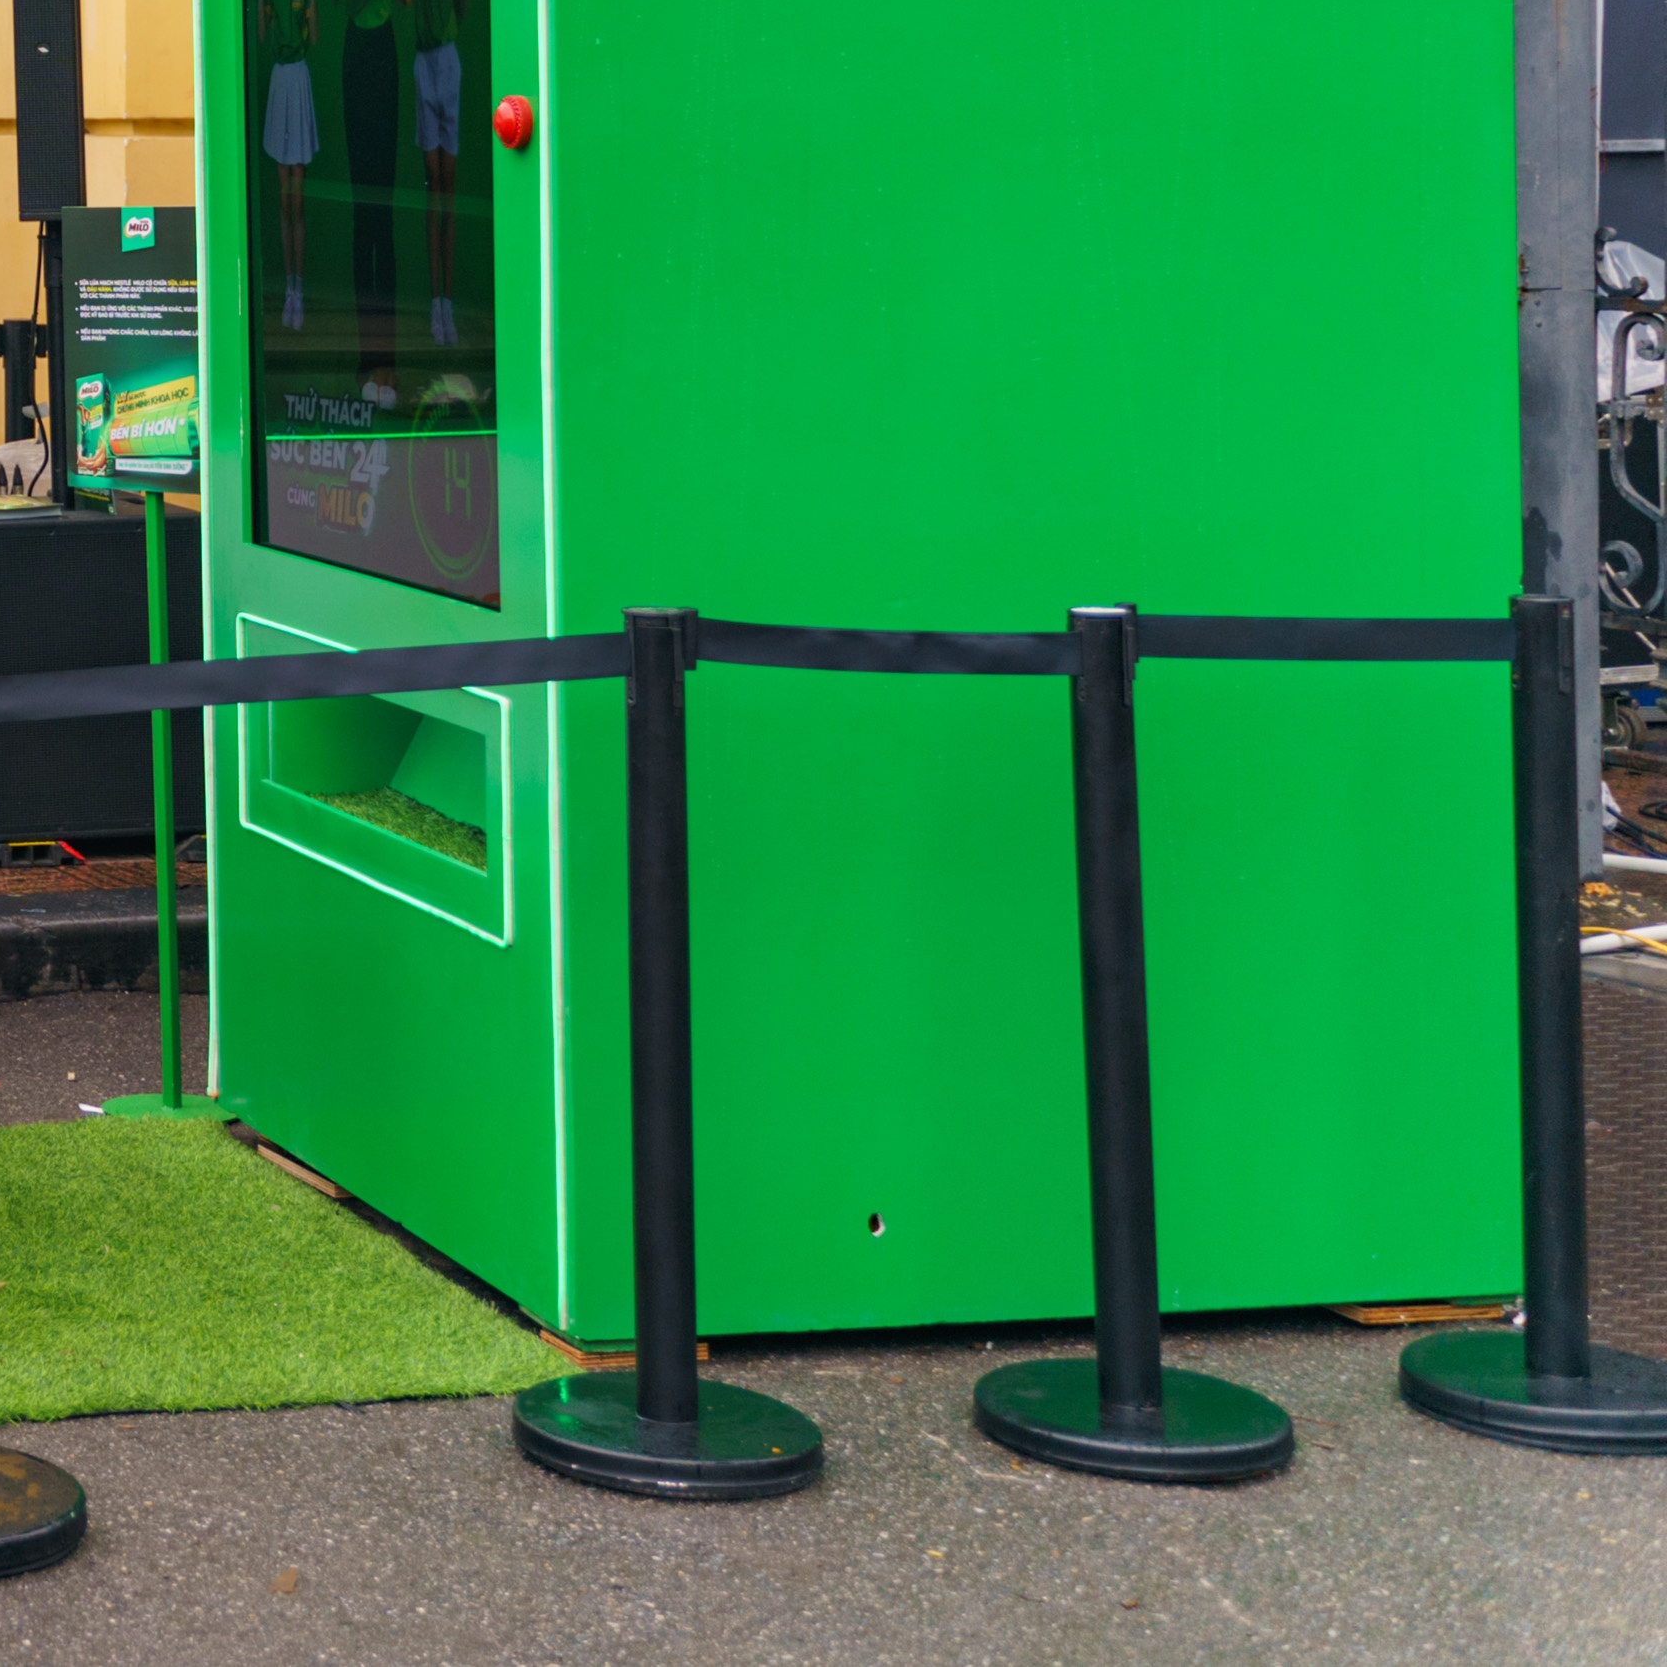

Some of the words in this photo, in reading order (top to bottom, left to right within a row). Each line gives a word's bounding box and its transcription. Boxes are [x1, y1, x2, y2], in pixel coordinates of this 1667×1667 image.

[128, 223, 149, 232] MILO
[319, 393, 374, 428] THÁCH
[317, 485, 376, 530] MILO
